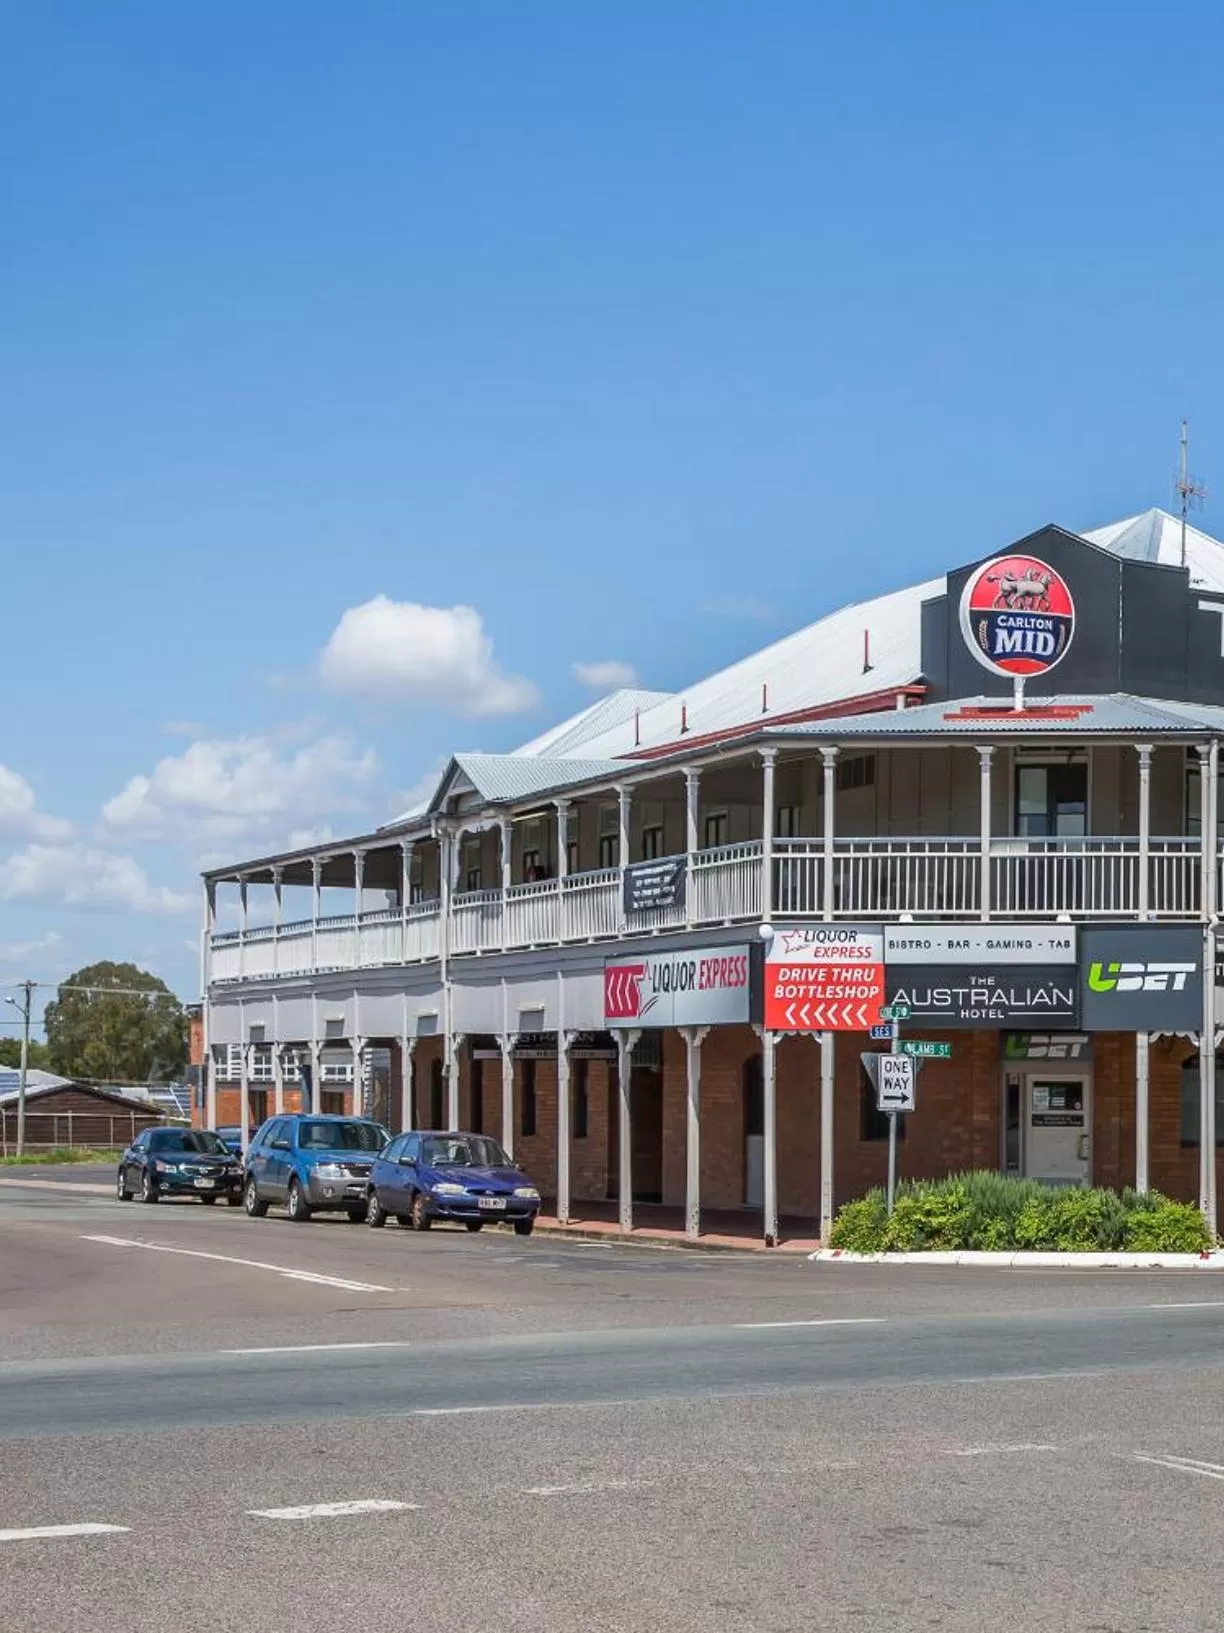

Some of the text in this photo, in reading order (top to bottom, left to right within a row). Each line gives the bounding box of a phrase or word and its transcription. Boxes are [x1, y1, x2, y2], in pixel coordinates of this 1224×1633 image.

[997, 615, 1053, 630] CARLTON
[993, 628, 1056, 656] MID
[805, 930, 858, 943] LIQUOR
[889, 940, 932, 949] BISTRO
[948, 940, 970, 949] BAR
[986, 940, 1033, 949] GAMING
[1048, 940, 1071, 949] TAB
[814, 946, 872, 958] EXPRESS
[653, 955, 747, 993] LIQUOR EXPRESS
[778, 968, 875, 982] DRIVE THRU
[970, 976, 995, 985] THE
[1088, 962, 1197, 992] UBET
[774, 984, 879, 999] BOTTLESHOP
[891, 988, 1073, 1006] AUSTRALIAN
[961, 1009, 1005, 1019] HOTEL
[884, 1061, 909, 1074] ONE
[884, 1078, 910, 1090] WAY
